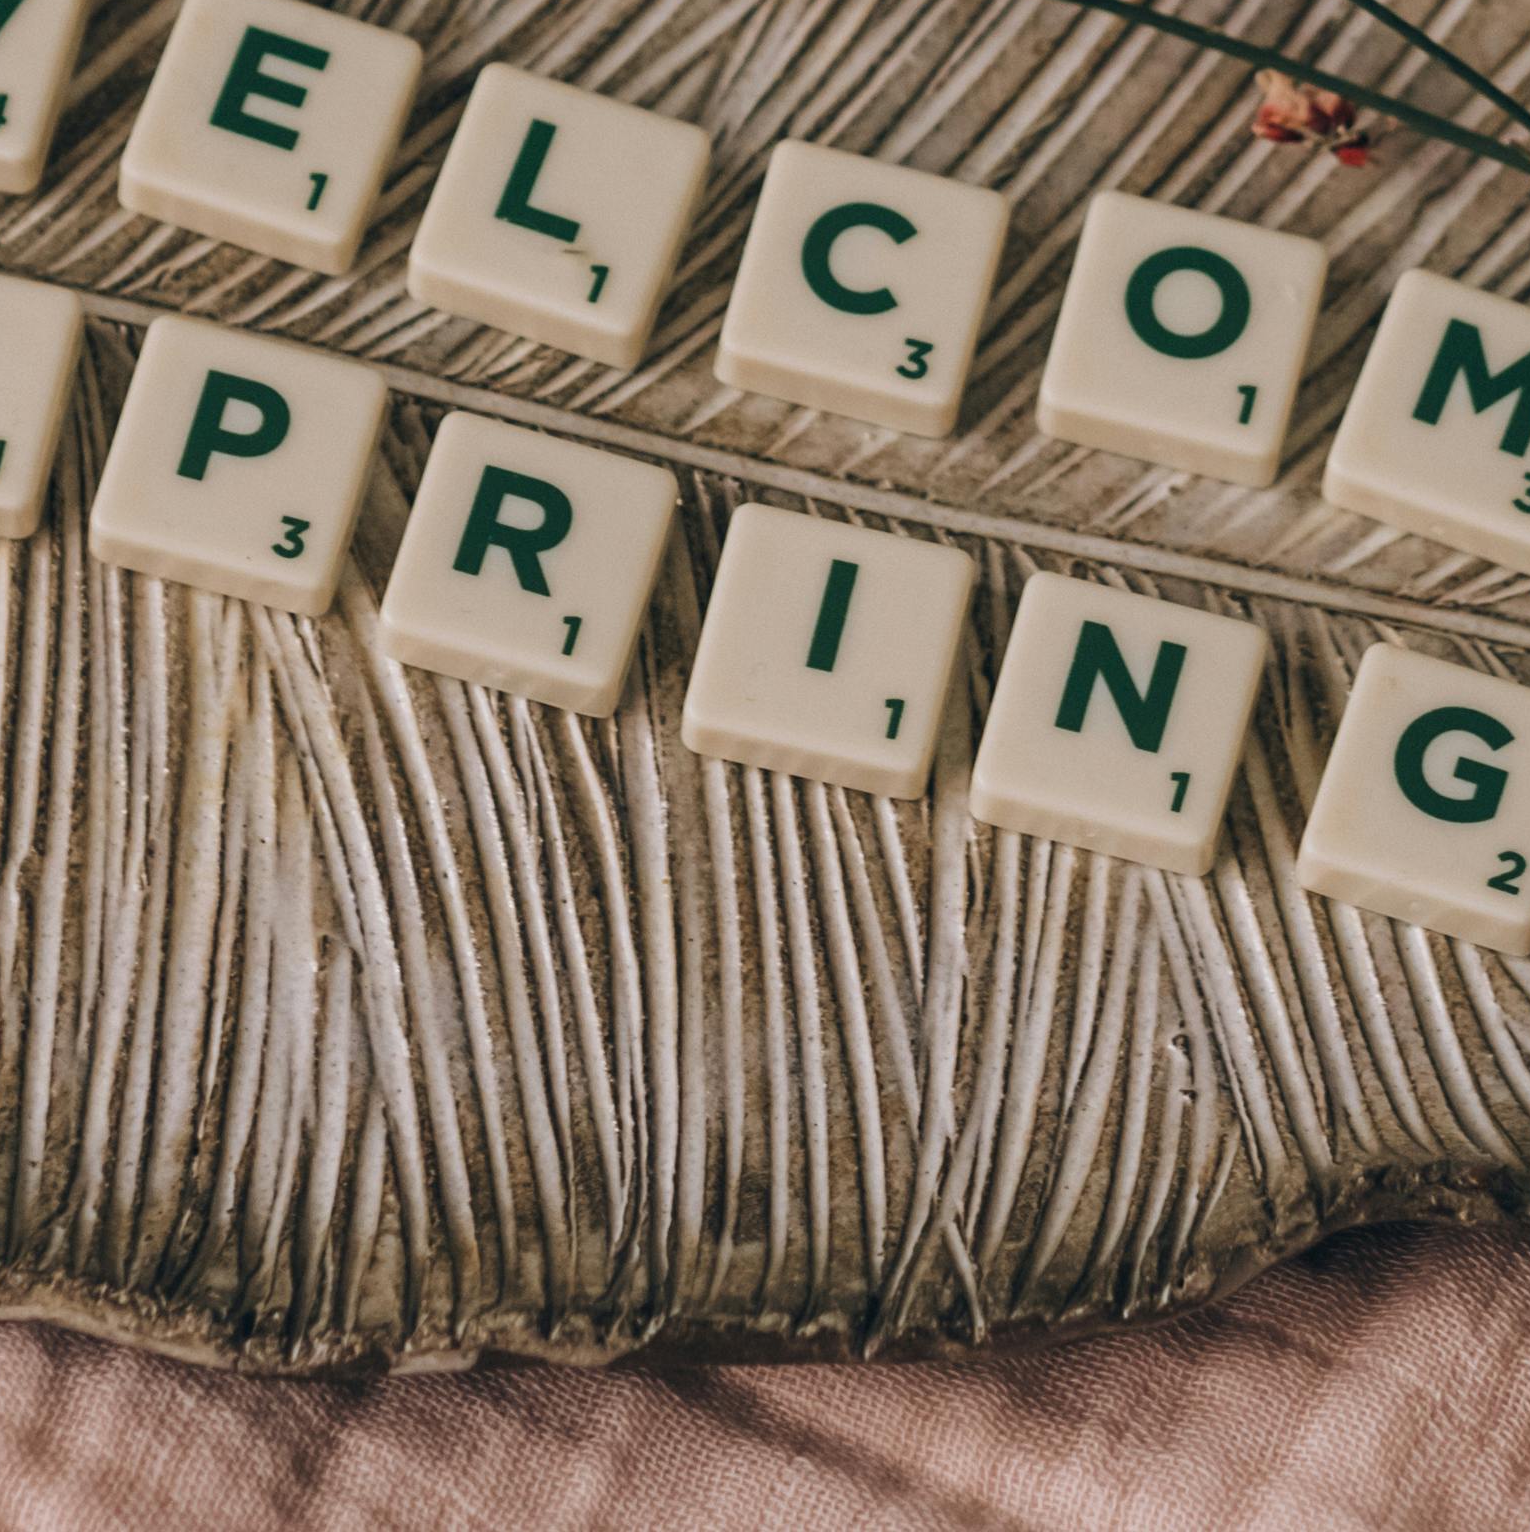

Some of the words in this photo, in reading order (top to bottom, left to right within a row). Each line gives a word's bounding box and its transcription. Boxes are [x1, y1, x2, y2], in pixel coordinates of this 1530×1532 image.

[307, 173, 328, 211] 1
[588, 265, 609, 303] 1
[896, 338, 933, 379] 3
[1238, 385, 1257, 424] 1
[272, 516, 310, 558] 3
[562, 616, 582, 656] 1
[885, 699, 905, 739] 1
[1171, 772, 1190, 812] 1
[1487, 851, 1527, 895] 2
